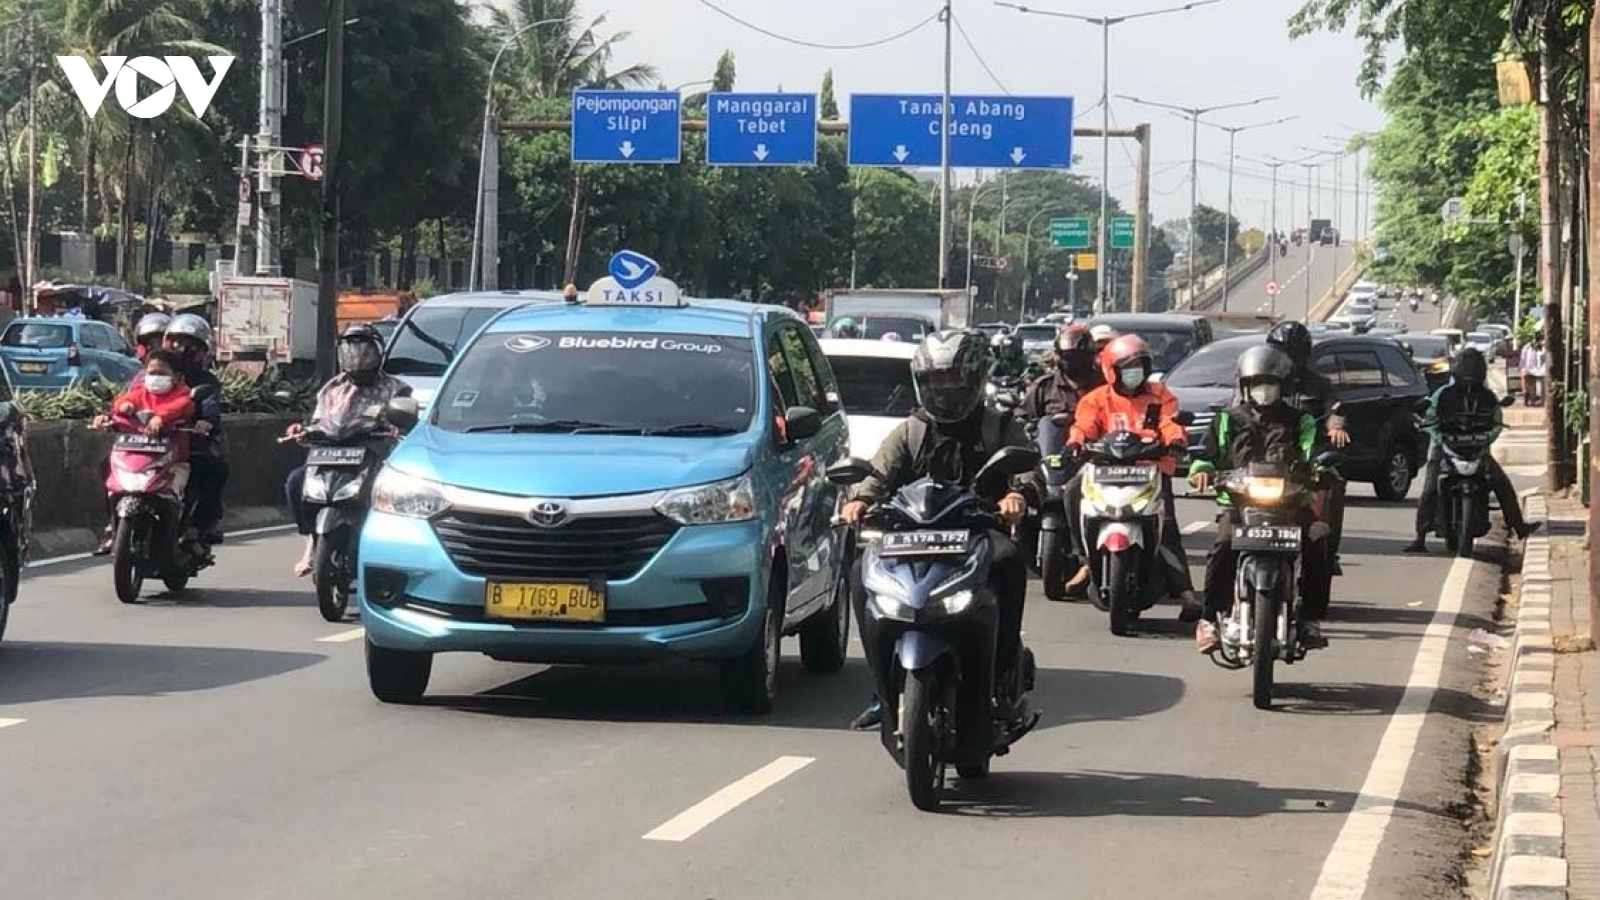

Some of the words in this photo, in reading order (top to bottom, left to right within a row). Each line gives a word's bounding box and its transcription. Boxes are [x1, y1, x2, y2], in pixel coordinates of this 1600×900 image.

[575, 96, 677, 114] Pejompongan
[717, 98, 808, 117] Manggarai
[966, 101, 1025, 121] Abang
[606, 115, 648, 134] Slipi
[737, 118, 787, 134] Tebet
[928, 120, 993, 140] Cdeng
[602, 289, 663, 303] TAKSI
[558, 336, 659, 350] Bluebird
[660, 339, 722, 355] Group
[491, 584, 503, 605] B
[519, 586, 559, 607] 1769
